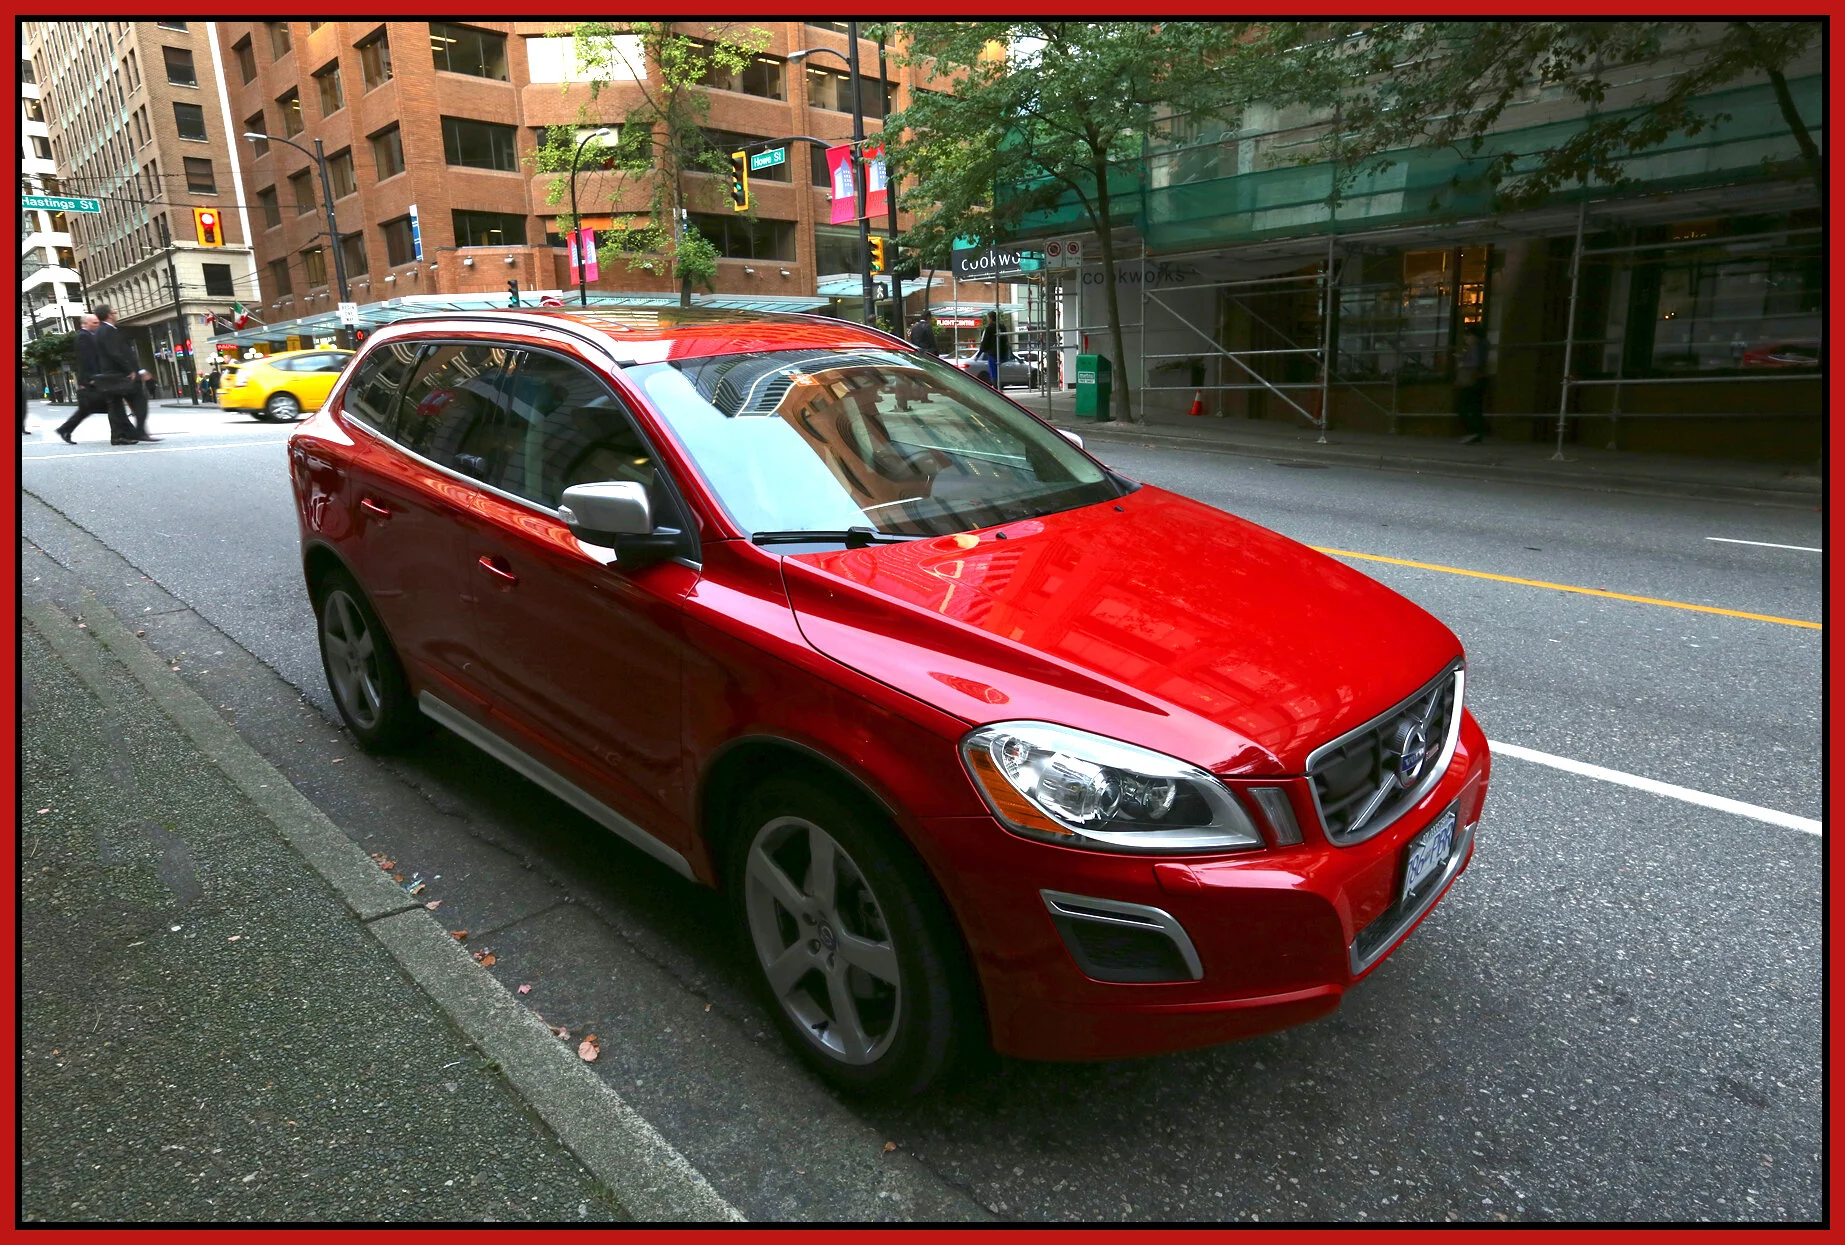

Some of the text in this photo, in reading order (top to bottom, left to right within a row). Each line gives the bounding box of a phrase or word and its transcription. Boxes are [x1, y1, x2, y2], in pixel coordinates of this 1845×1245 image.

[754, 152, 782, 167] Howe St
[22, 197, 94, 209] Hastings St
[1083, 267, 1185, 285] cokworks
